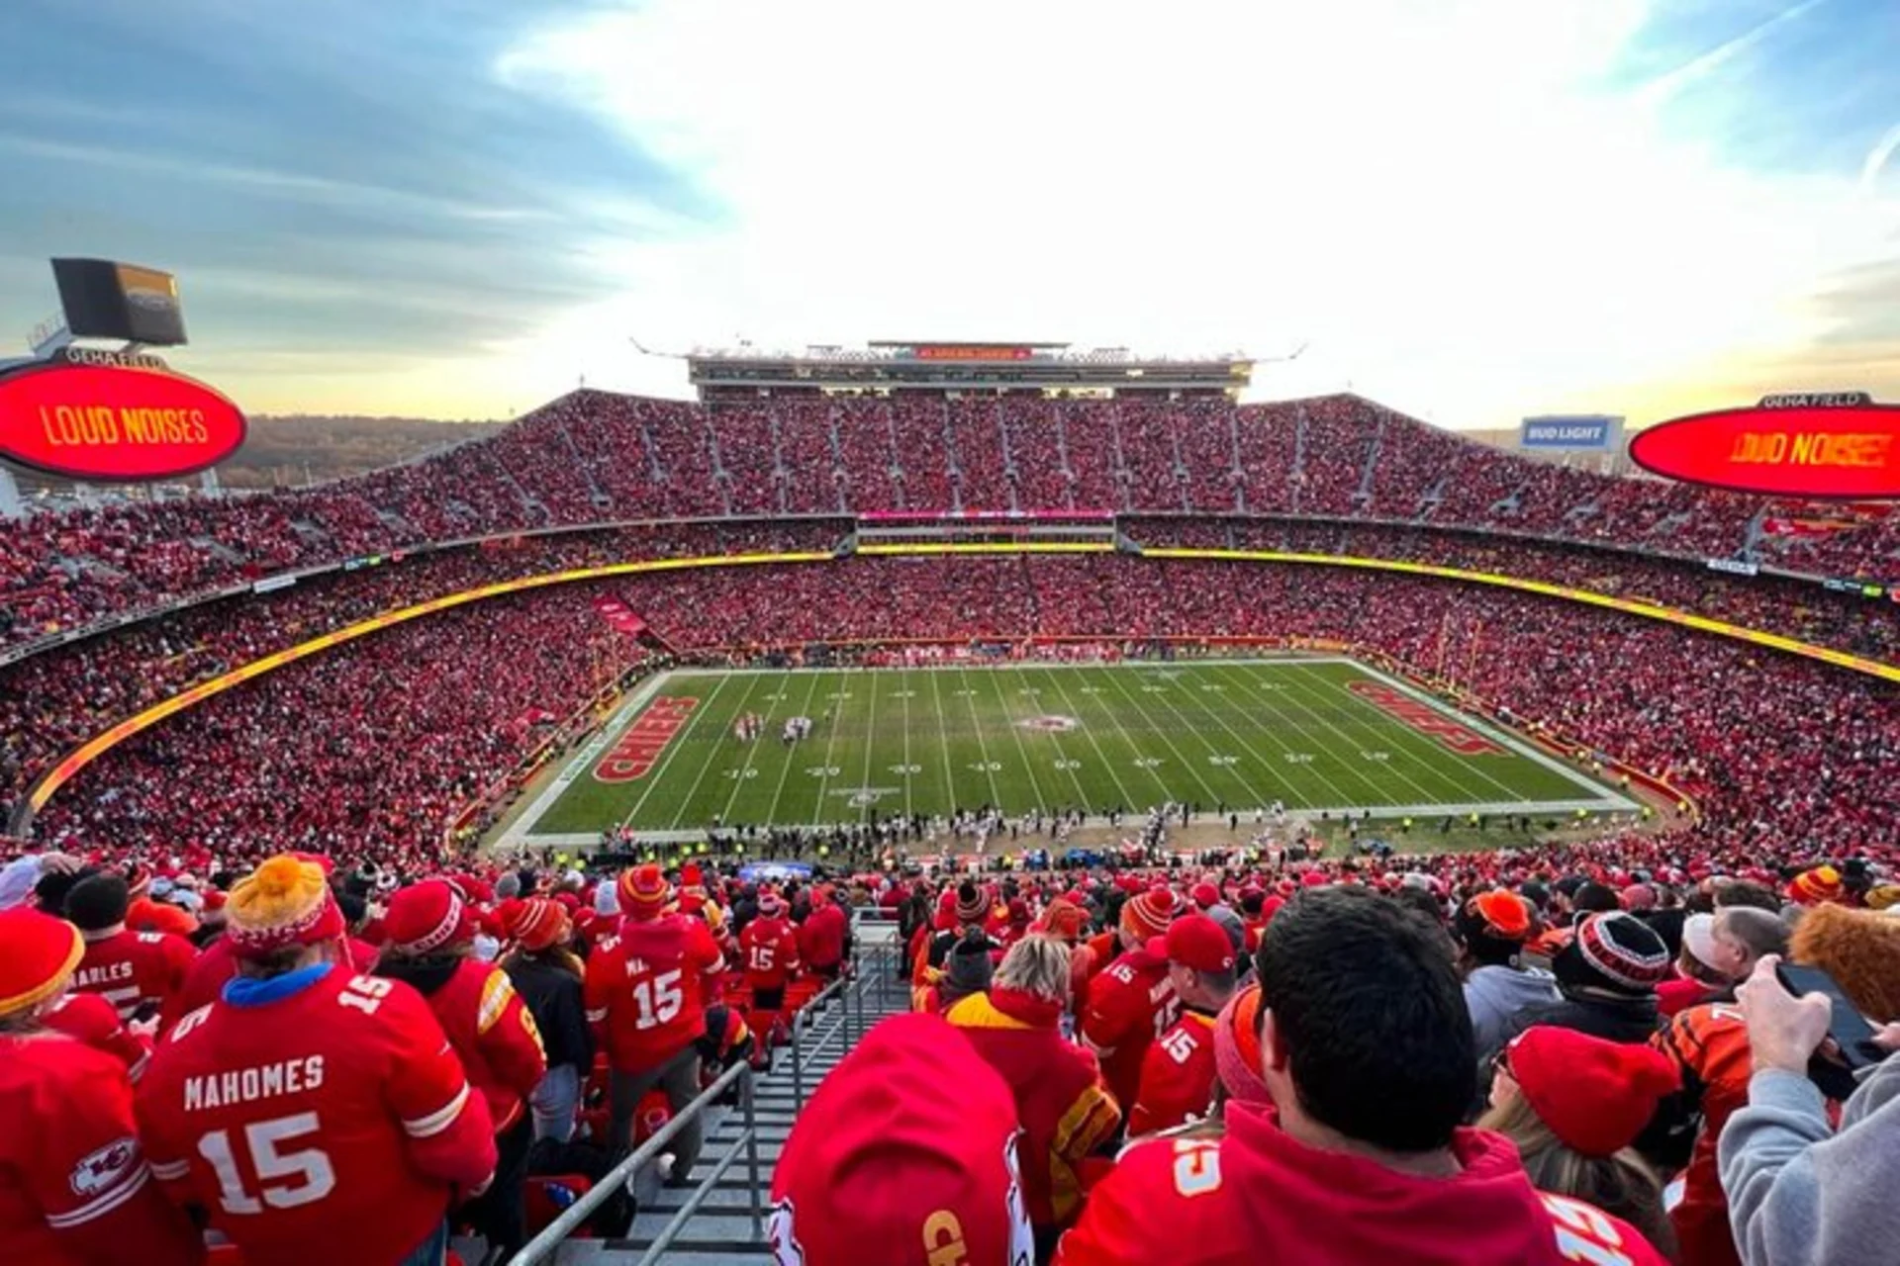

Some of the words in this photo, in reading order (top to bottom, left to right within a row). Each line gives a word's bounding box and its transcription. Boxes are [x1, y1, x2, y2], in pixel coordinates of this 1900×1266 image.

[40, 405, 119, 446] LOUD
[120, 407, 208, 444] NOISES
[1529, 426, 1558, 440] BUD
[1559, 426, 1602, 440] LIGHT
[592, 695, 700, 783] CHIEFS
[749, 945, 774, 972] 15
[337, 974, 394, 1015] 15
[632, 967, 683, 1030] 15
[1161, 1027, 1199, 1065] 15
[184, 1054, 325, 1112] MAHOMES
[198, 1111, 337, 1215] 15
